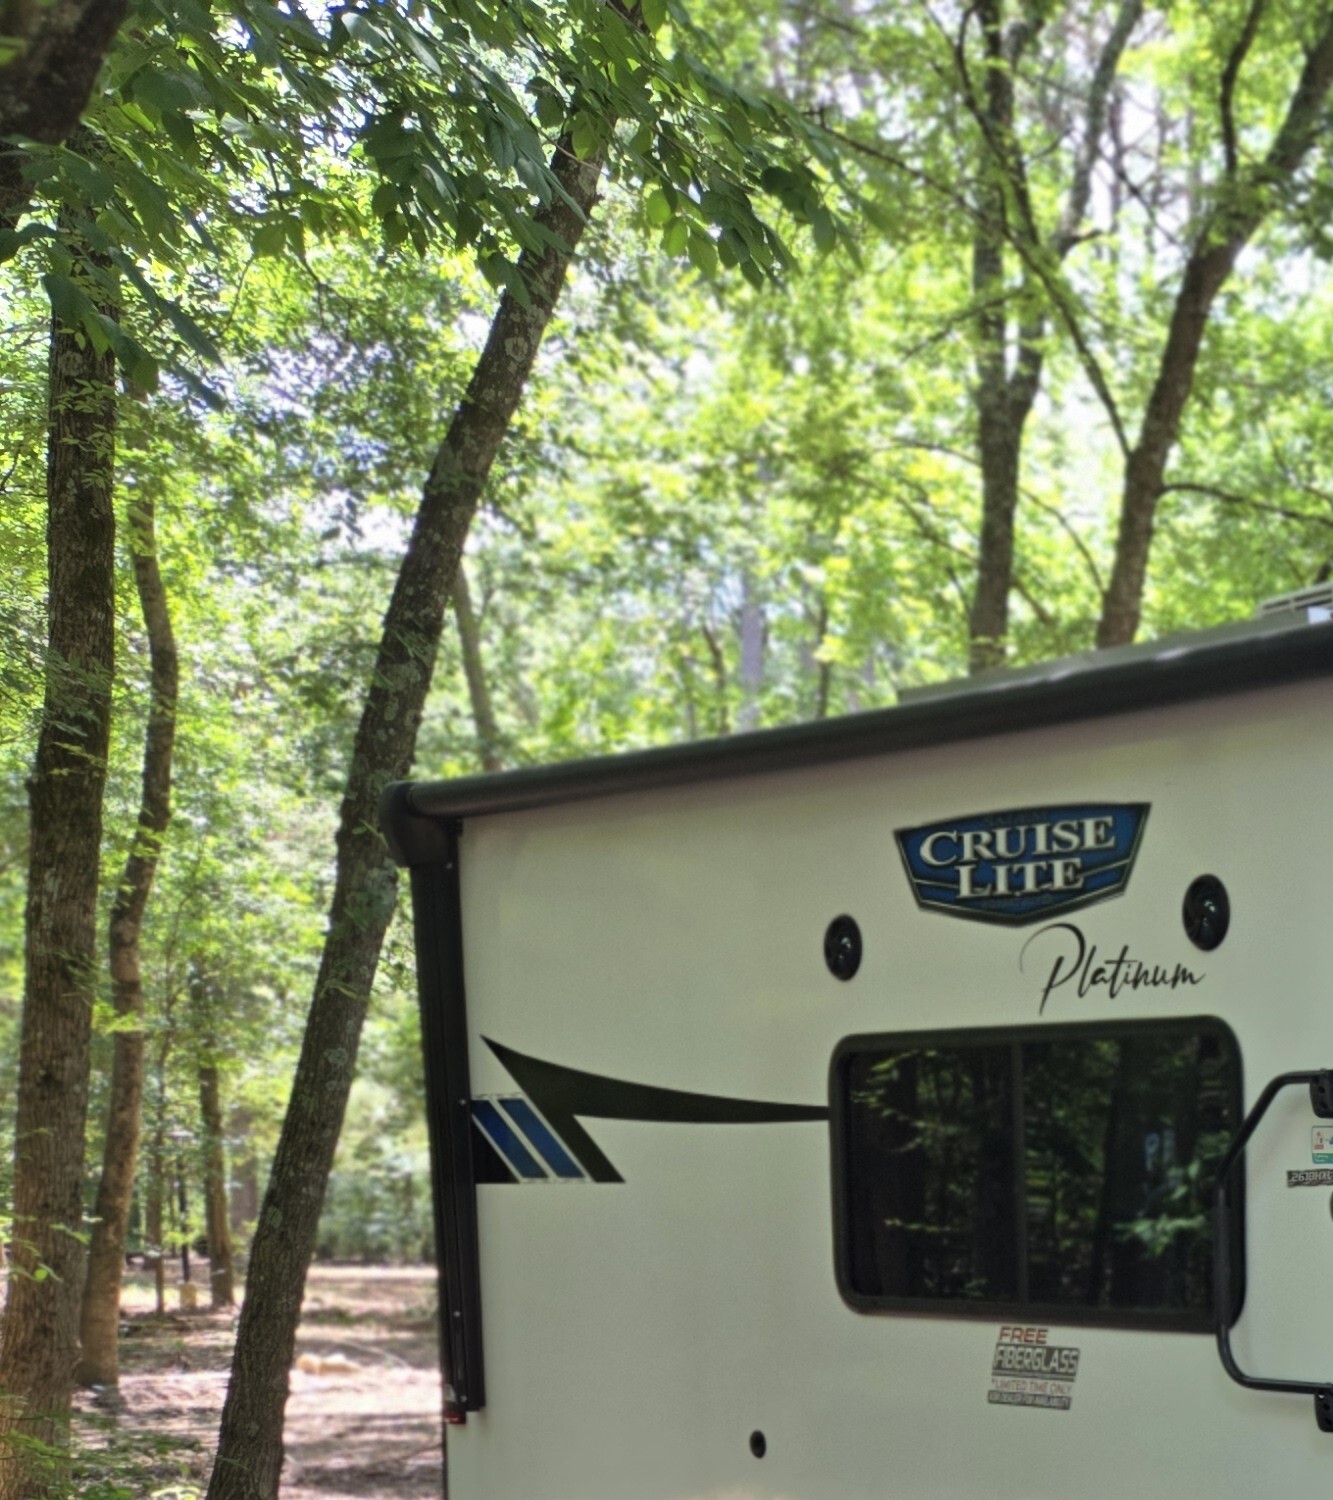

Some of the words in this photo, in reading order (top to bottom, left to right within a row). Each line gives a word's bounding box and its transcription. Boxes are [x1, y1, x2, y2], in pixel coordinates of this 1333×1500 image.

[919, 816, 1117, 867] CRUISE
[955, 857, 1085, 899] LITE
[1020, 922, 1206, 1016] Platinum
[999, 1326, 1049, 1345] FREE
[993, 1346, 1079, 1374] FIBERGLASS
